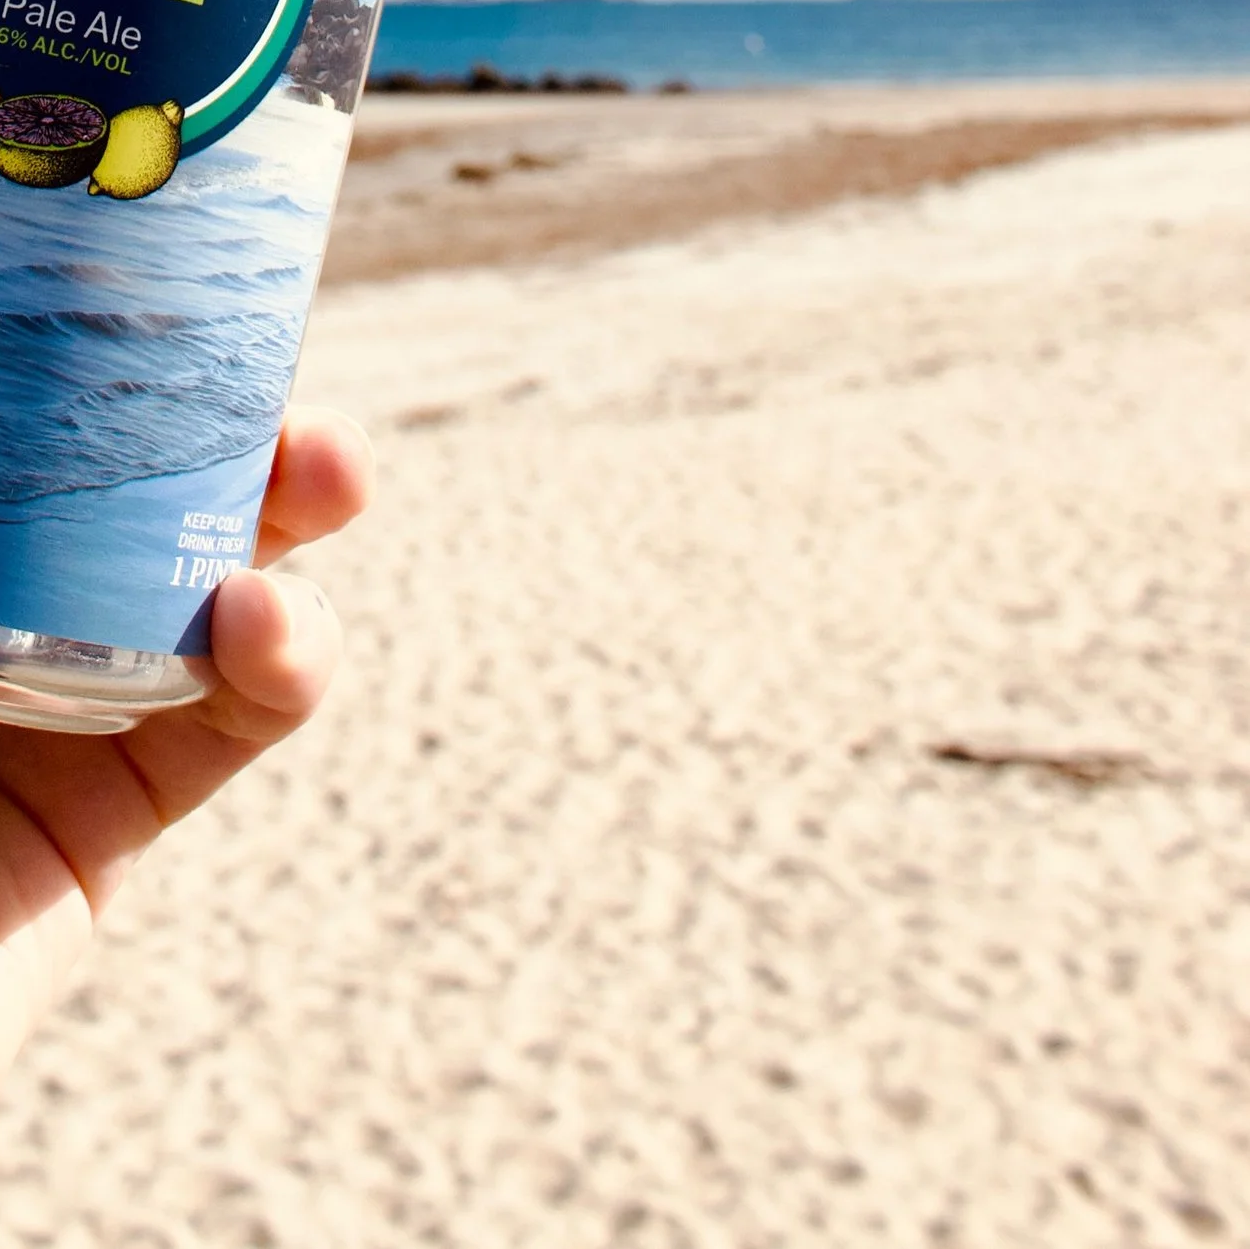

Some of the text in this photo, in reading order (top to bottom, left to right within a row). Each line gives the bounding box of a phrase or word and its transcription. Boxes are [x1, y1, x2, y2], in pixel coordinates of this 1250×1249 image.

[83, 11, 141, 50] Ale
[32, 36, 132, 75] ALC./VOL
[182, 511, 243, 533] KEEP COLD
[177, 532, 246, 553] DRINK FRESH
[169, 556, 184, 586] 1
